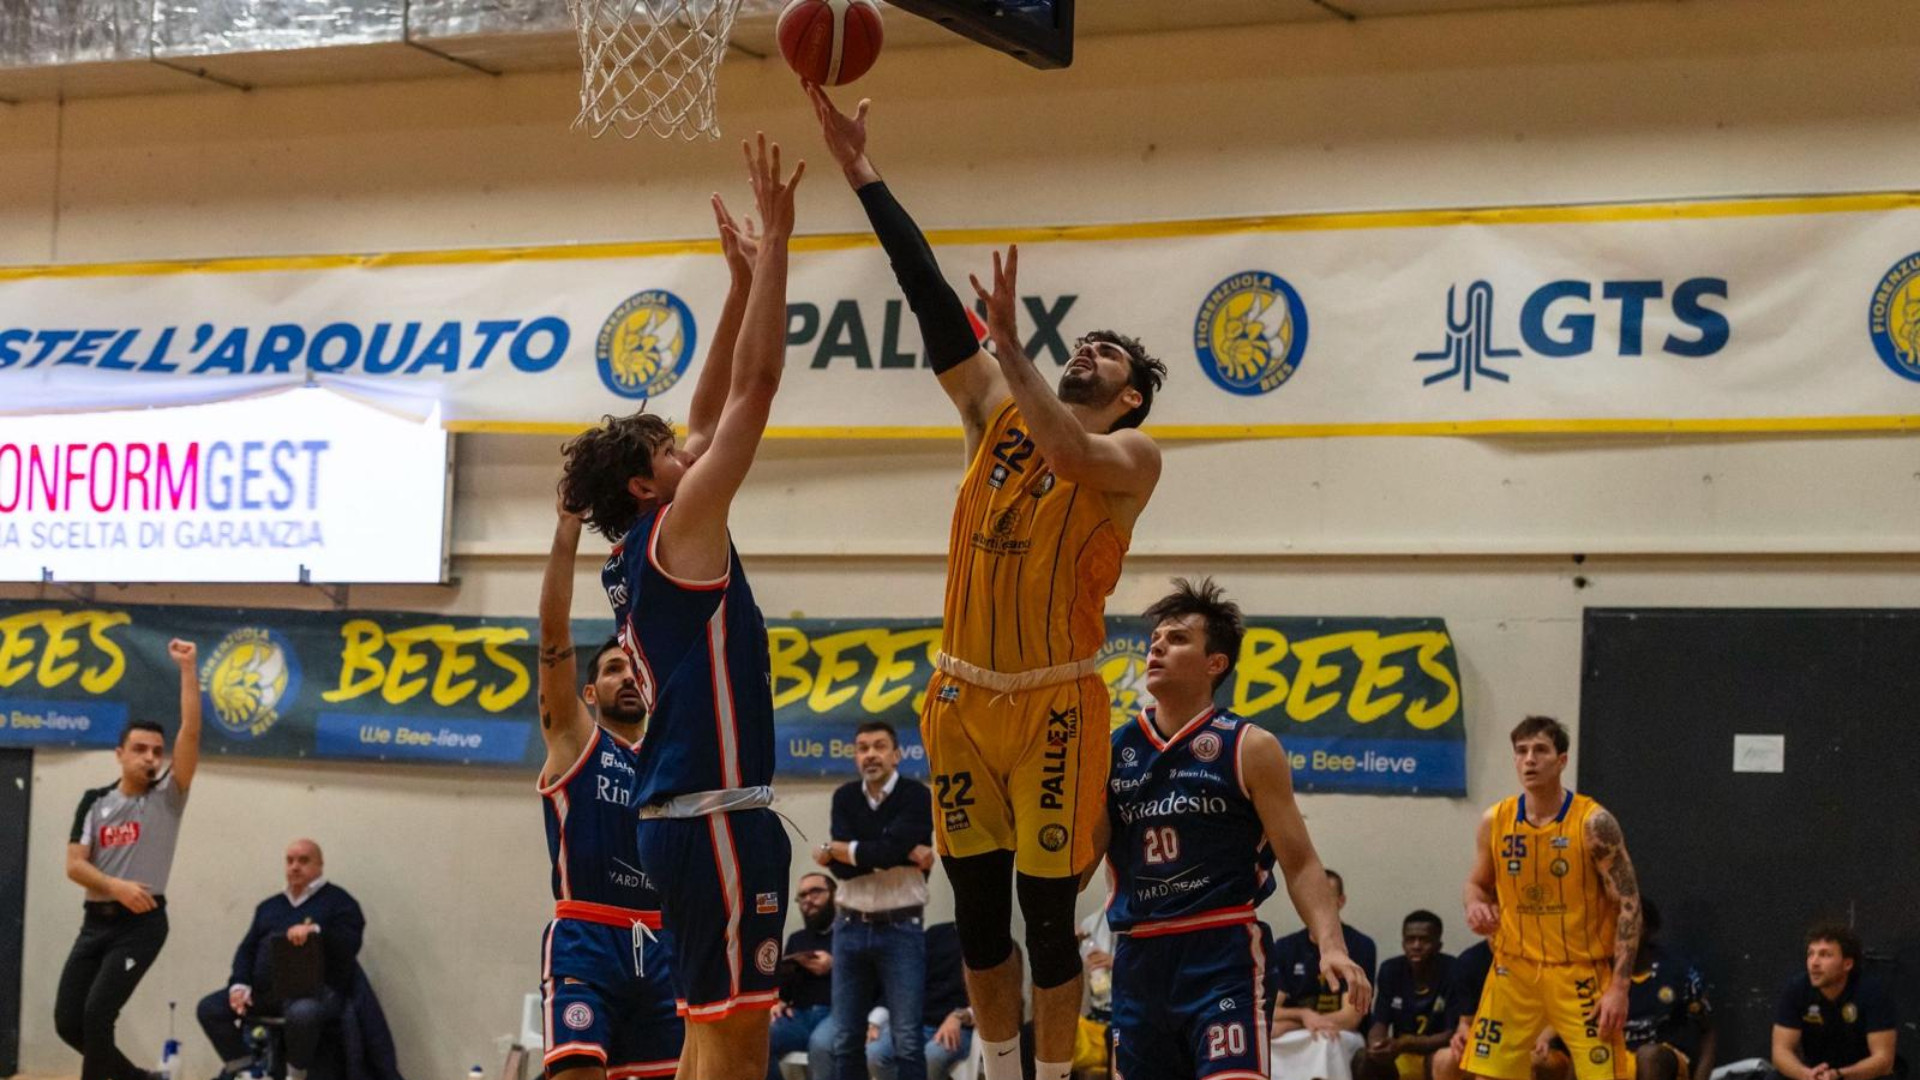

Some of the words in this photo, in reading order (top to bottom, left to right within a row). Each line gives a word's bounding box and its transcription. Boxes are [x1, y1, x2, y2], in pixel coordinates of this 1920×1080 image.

[1519, 276, 1730, 358] GTS
[992, 428, 1035, 474] 22
[30, 521, 127, 549] SCELTA
[139, 522, 164, 548] DI
[174, 521, 325, 549] GARANZIA
[321, 618, 531, 712] BEES
[1229, 627, 1460, 730] BEES
[360, 726, 390, 743] We
[396, 727, 482, 748] Bee-lieve
[1069, 706, 1078, 738] ITALIA
[790, 738, 824, 757] We
[1040, 708, 1070, 810] PALLEX
[1312, 750, 1417, 773] Bee-lieve
[935, 771, 975, 810] 22
[1144, 825, 1181, 865] 20
[1502, 834, 1527, 858] 35
[1136, 882, 1170, 902] YARD
[1208, 1023, 1246, 1060] 20
[1475, 1017, 1503, 1044] 35
